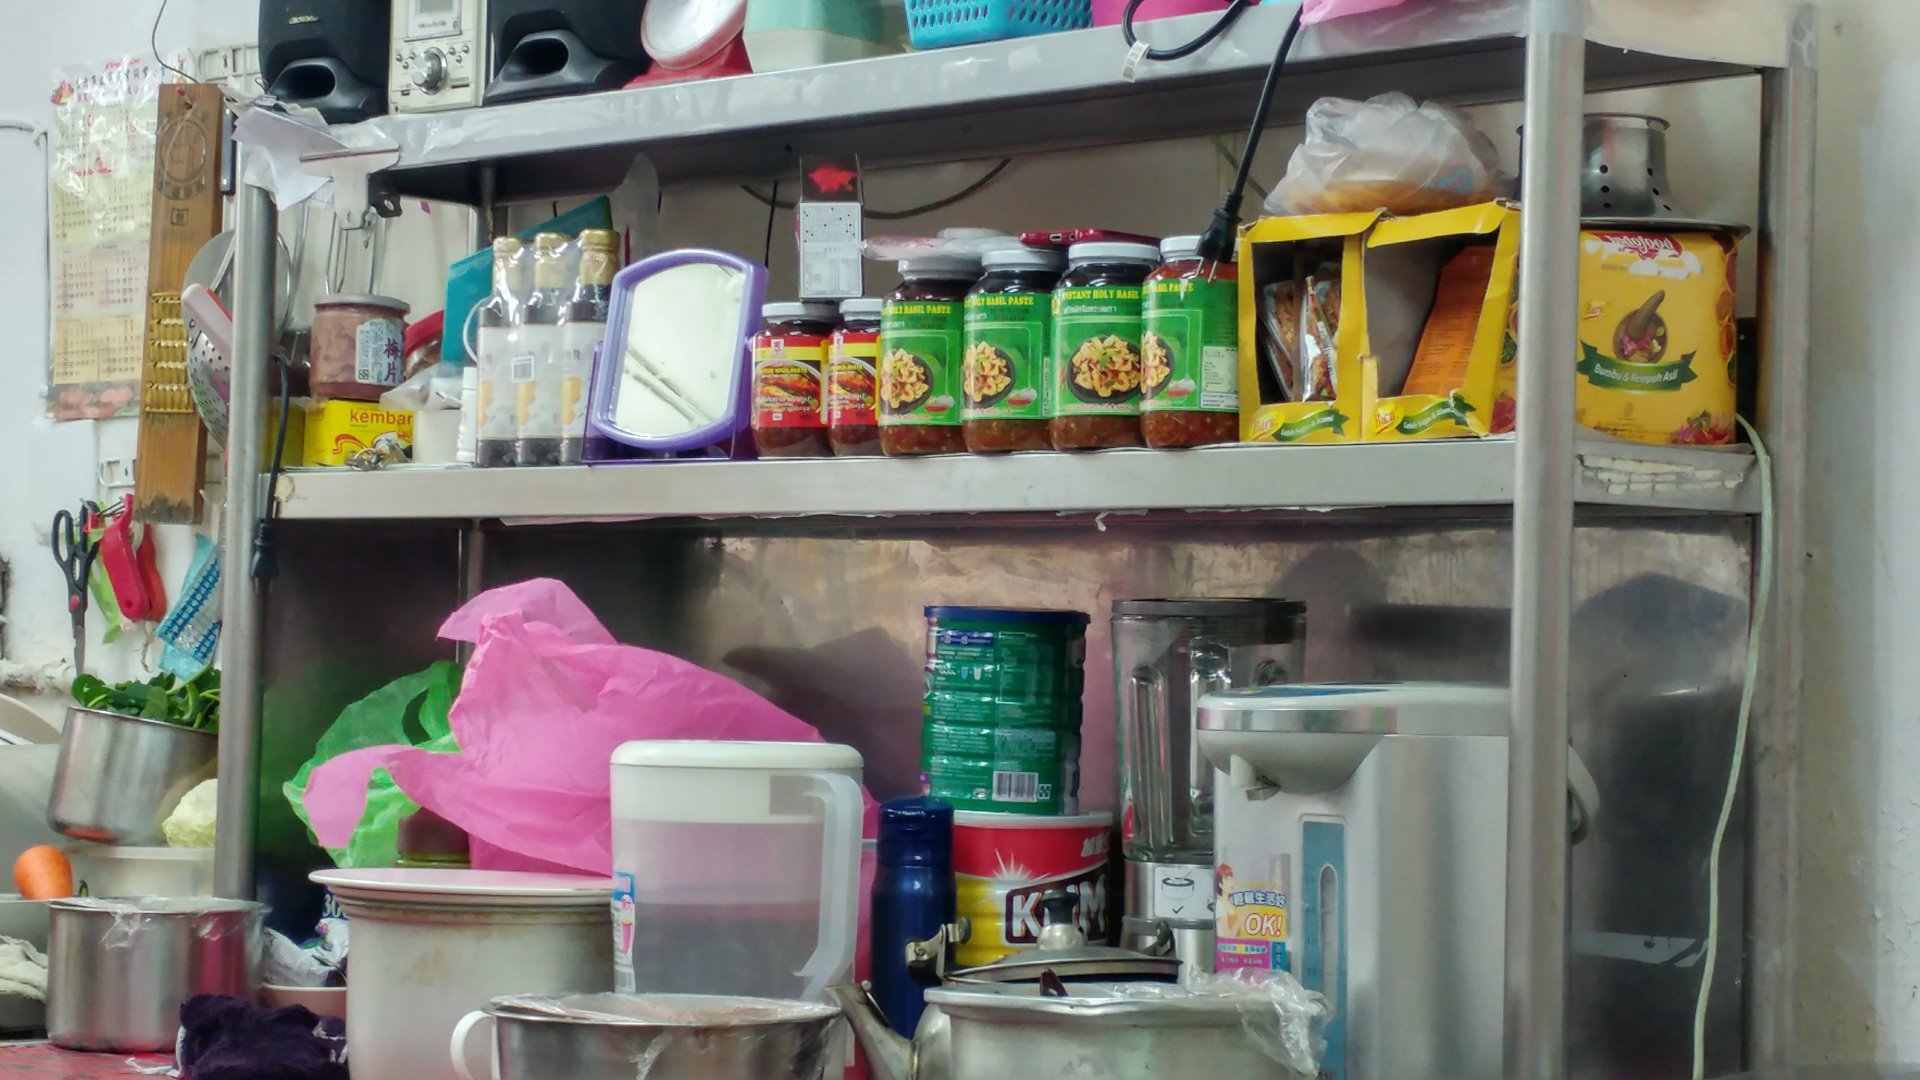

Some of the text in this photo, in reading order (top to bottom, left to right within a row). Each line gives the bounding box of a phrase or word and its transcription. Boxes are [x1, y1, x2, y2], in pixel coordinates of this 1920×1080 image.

[1093, 289, 1115, 299] HOLY
[1117, 289, 1140, 299] BASIL
[1169, 282, 1194, 293] PAE
[986, 295, 1007, 306] BASIL
[1008, 295, 1034, 305] PASTE
[926, 303, 952, 314] PASTE
[1594, 363, 1621, 381] Bumbu
[1622, 373, 1630, 382] &
[1662, 368, 1679, 382] Asli
[323, 893, 348, 919] 30
[1012, 873, 1106, 939] KM
[1245, 912, 1282, 937] OK!
